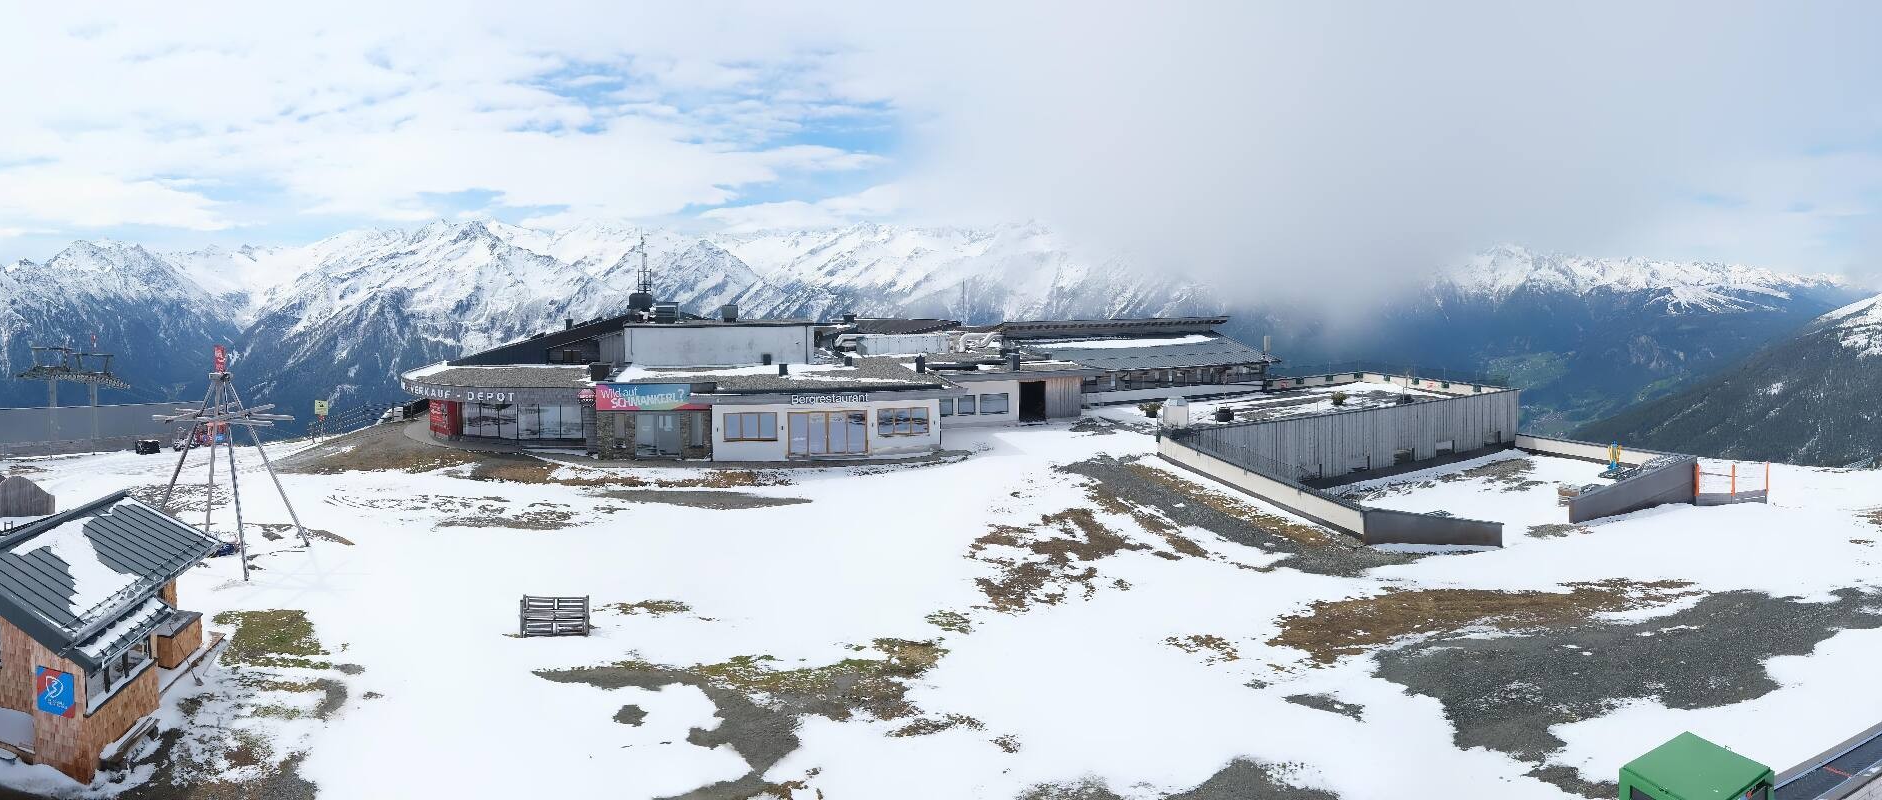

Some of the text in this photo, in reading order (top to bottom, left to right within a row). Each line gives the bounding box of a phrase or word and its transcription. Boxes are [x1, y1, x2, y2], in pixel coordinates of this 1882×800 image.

[410, 385, 451, 399] VERKAUF
[467, 391, 515, 402] DEPOT
[600, 386, 638, 399] Wild auf
[791, 393, 870, 405] Bergrestaurant
